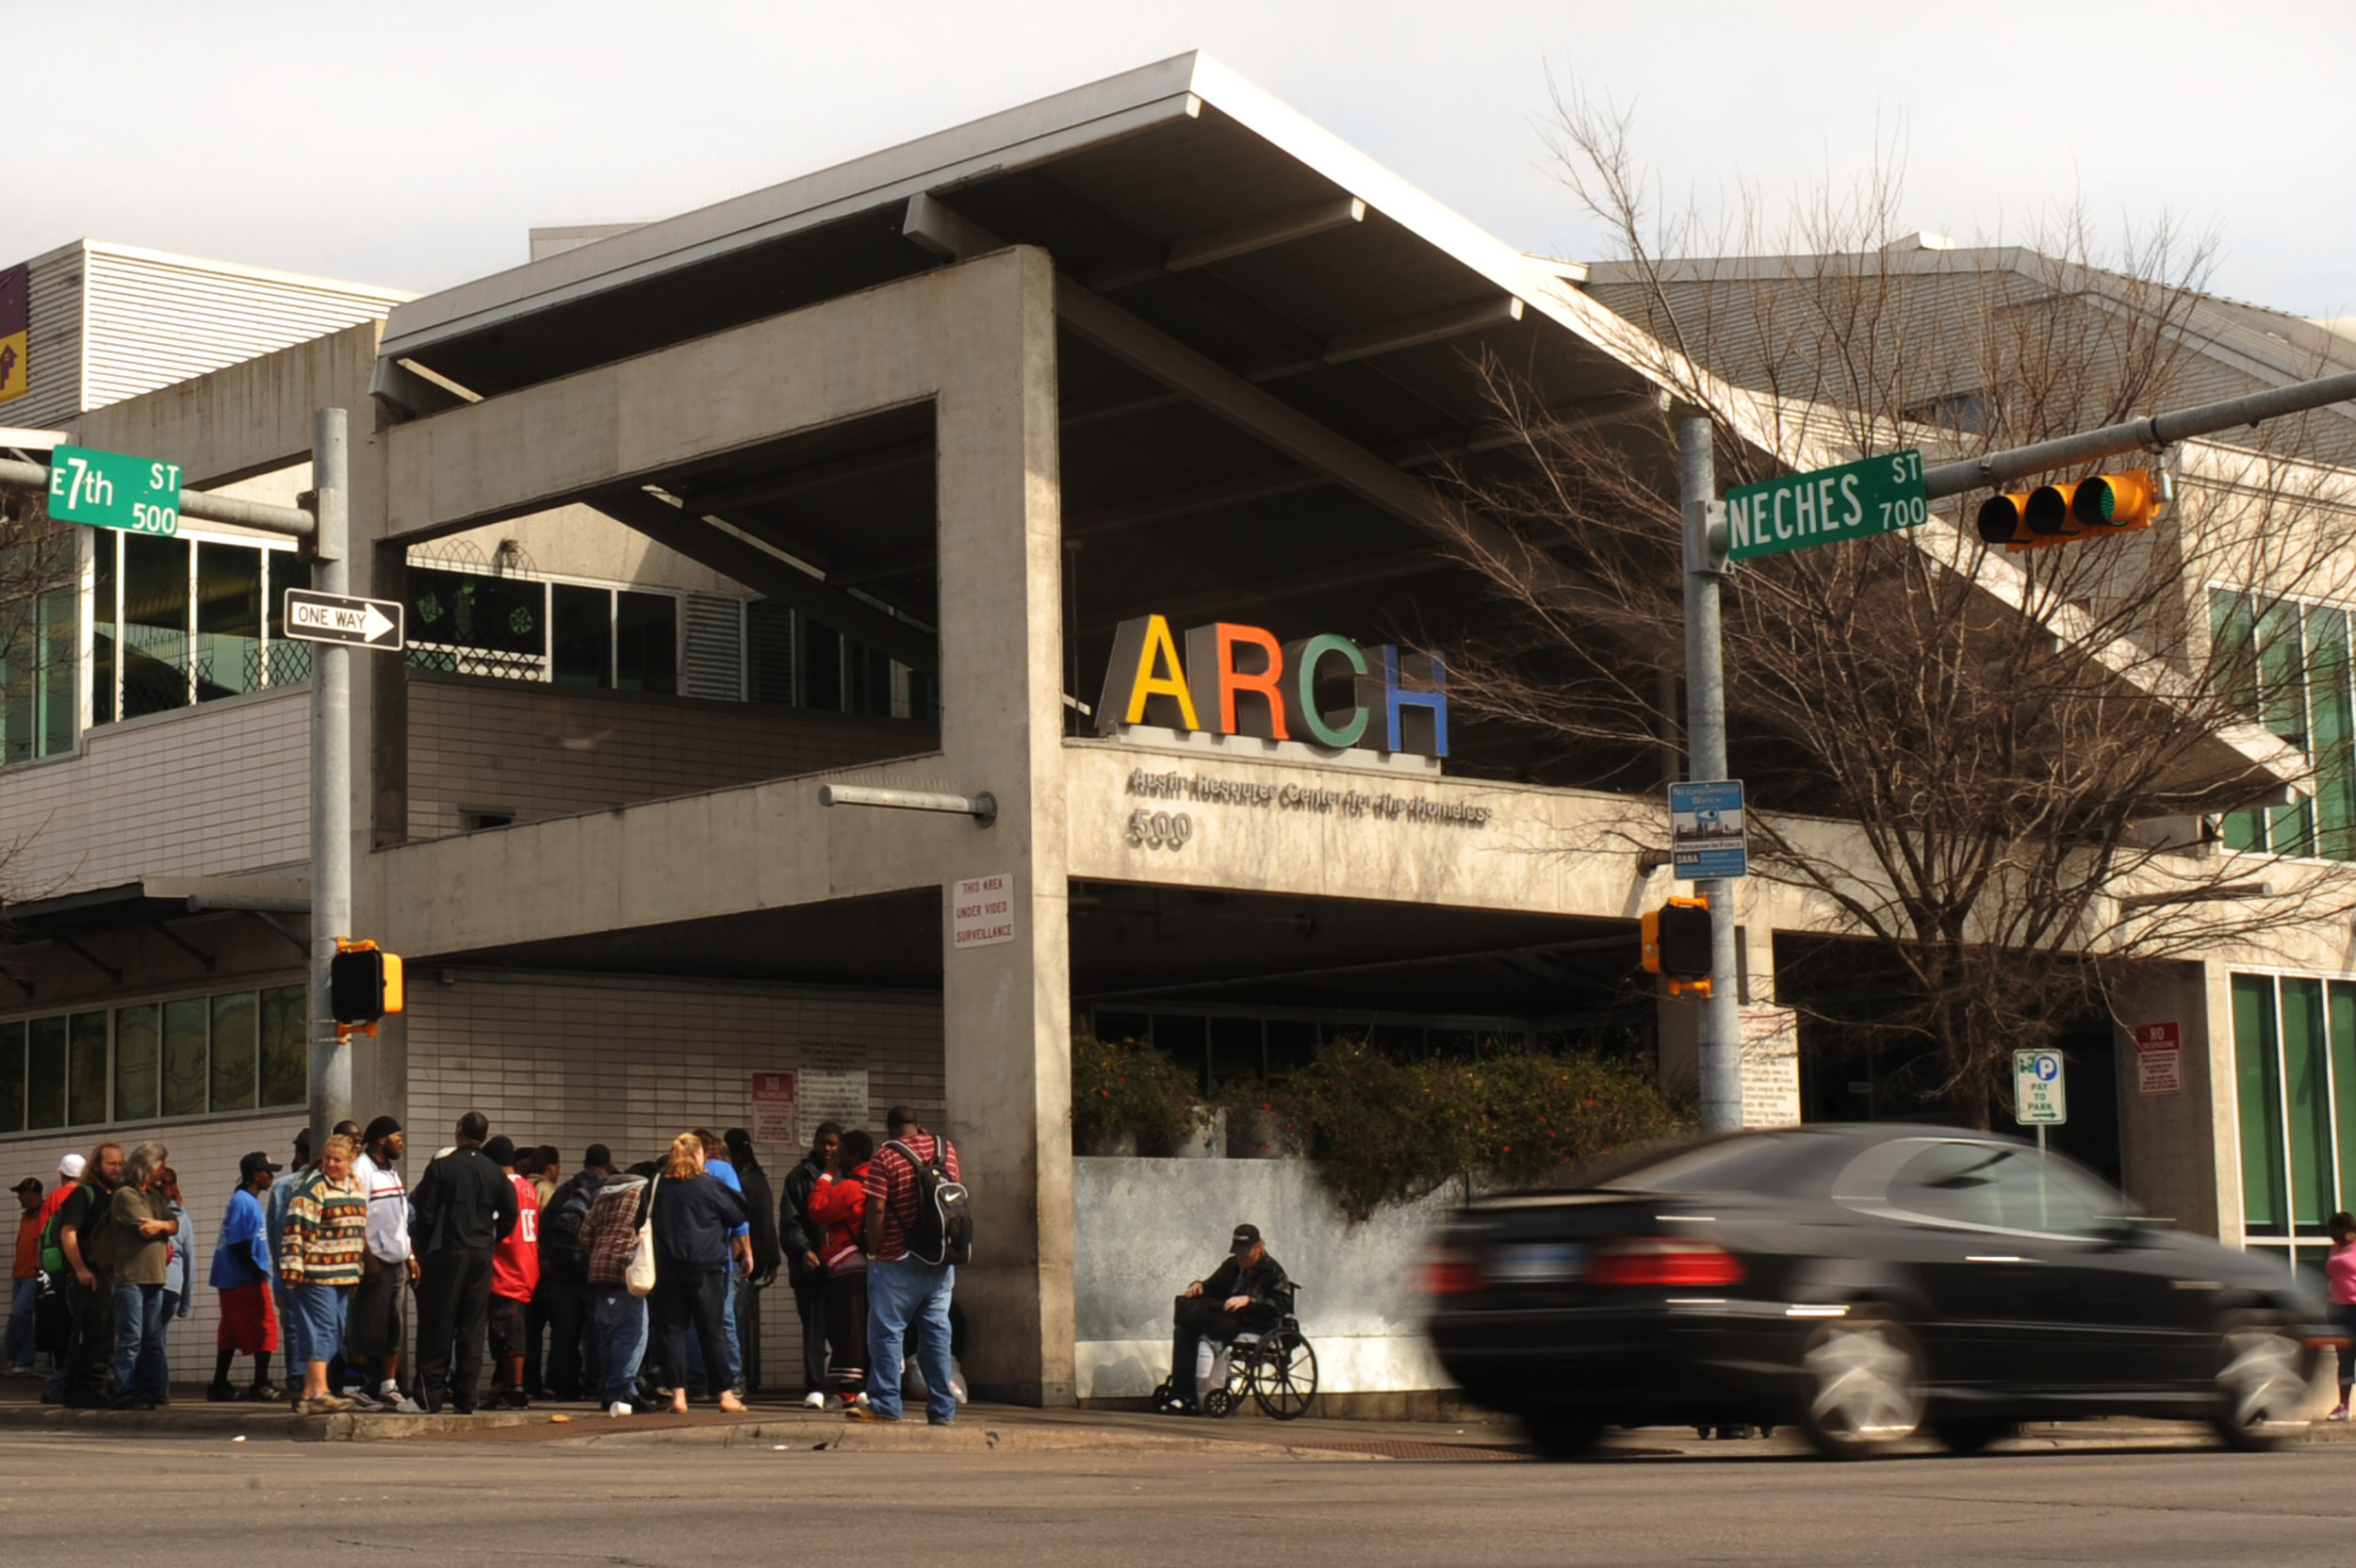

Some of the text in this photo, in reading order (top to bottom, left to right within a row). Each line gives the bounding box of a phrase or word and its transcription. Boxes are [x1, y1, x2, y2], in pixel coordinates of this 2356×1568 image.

[149, 462, 179, 492] ST
[1729, 453, 1918, 549] NECHES ST
[132, 502, 176, 534] 500
[1879, 496, 1925, 530] 700
[299, 606, 367, 629] ONE WAY
[1122, 613, 1448, 758] ARCH
[1132, 767, 1189, 794] Austin
[1195, 773, 1279, 803] Resource
[1286, 782, 1343, 807] Center
[1380, 793, 1407, 814] the
[1413, 796, 1494, 824] Homeless
[1131, 808, 1193, 843] 500
[963, 878, 1003, 893] THIS AREA
[957, 901, 1006, 919] UNDER VIDEO
[957, 924, 1011, 942] SURVEILLANCE
[2150, 1026, 2164, 1040] NO
[765, 1076, 780, 1091] NO
[2031, 1083, 2048, 1091] PAY
[2027, 1102, 2053, 1111] PARK
[2034, 1092, 2046, 1102] TO
